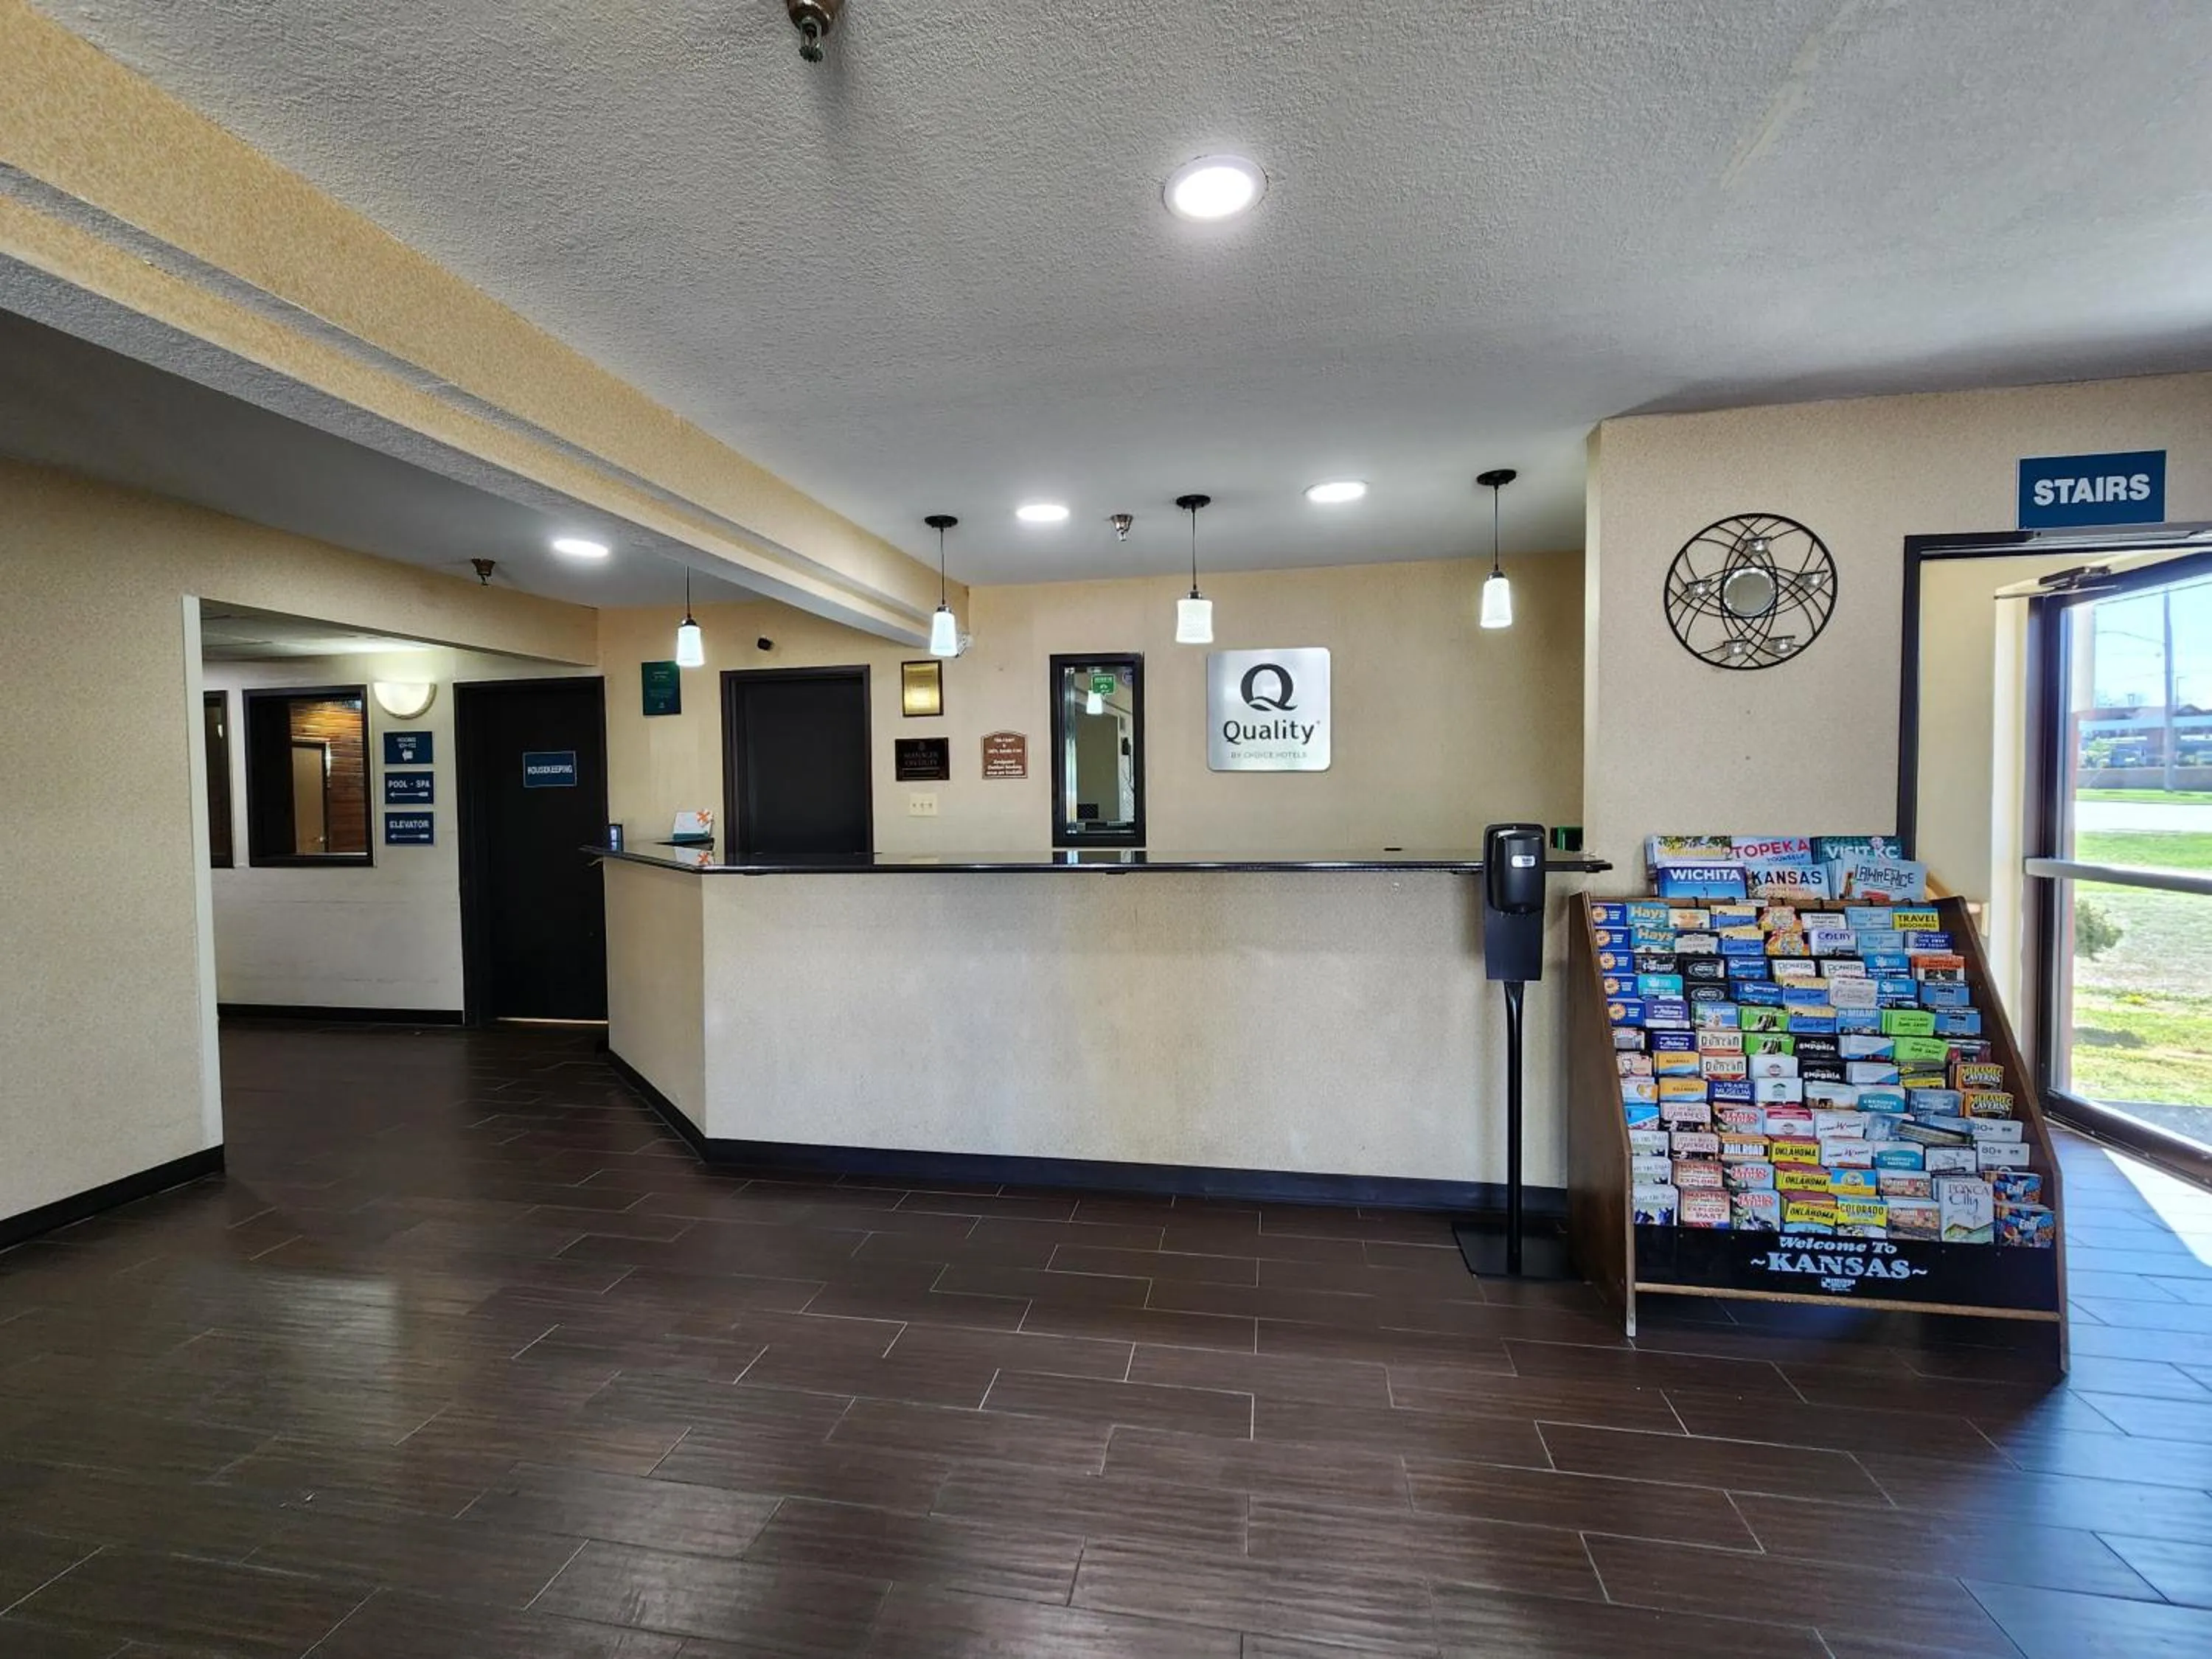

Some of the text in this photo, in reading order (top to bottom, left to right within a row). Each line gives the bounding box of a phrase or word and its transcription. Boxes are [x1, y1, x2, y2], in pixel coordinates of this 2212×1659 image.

[2034, 473, 2151, 507] STAIRS
[1240, 663, 1298, 712] Q
[1222, 719, 1315, 745] Quality
[526, 765, 573, 776] HOUSEKEEPING
[388, 779, 408, 788] POOL
[416, 779, 431, 788] SPA
[389, 820, 430, 829] ELEVATOR
[1732, 838, 1809, 859] TOPEKA
[1669, 869, 1741, 881] WICHITA
[1751, 870, 1823, 886] KANSAS
[1854, 863, 1915, 888] LAWRENCE
[1630, 905, 1666, 919] Hays
[1899, 914, 1937, 922] TRAVEL
[1638, 928, 1674, 942] Hays
[1775, 1146, 1817, 1157] OKLAHOMA
[1785, 1175, 1827, 1186] OKLAHOMA
[1790, 1207, 1835, 1220] OKLAHOMA
[1840, 1203, 1885, 1215] COLORADO
[1778, 1236, 1898, 1254] Welcome To
[1767, 1252, 1911, 1279] KANSAS
